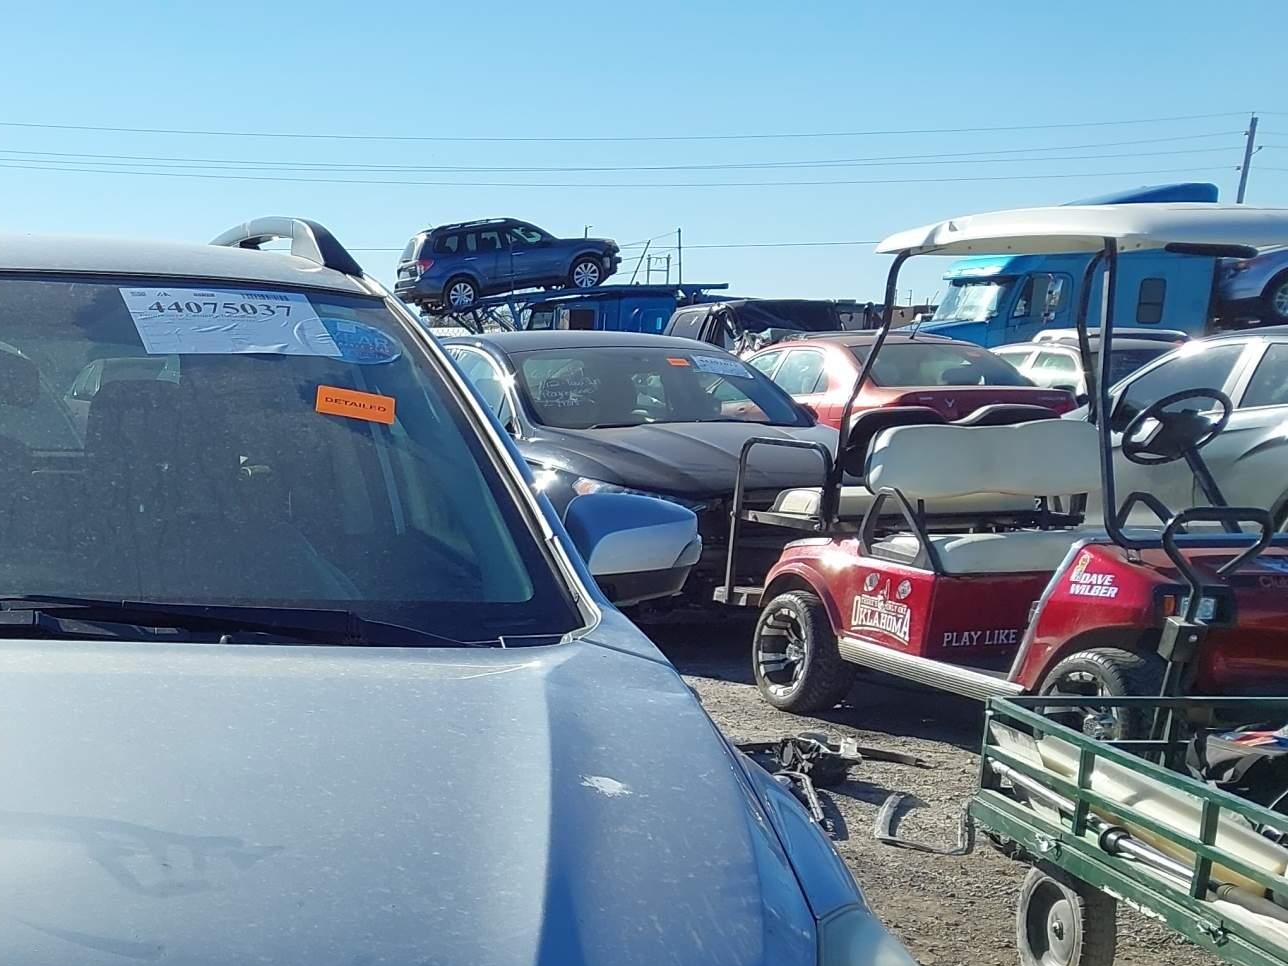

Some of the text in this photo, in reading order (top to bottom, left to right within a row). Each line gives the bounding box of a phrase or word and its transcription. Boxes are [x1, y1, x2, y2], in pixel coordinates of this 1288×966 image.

[148, 301, 292, 317] 44075037
[324, 396, 387, 413] DETAILED
[1080, 572, 1115, 586] DAVE
[1069, 583, 1119, 598] WILBER
[851, 595, 911, 642] OKLAHOMA
[942, 629, 1019, 647] PLAY LIKE
